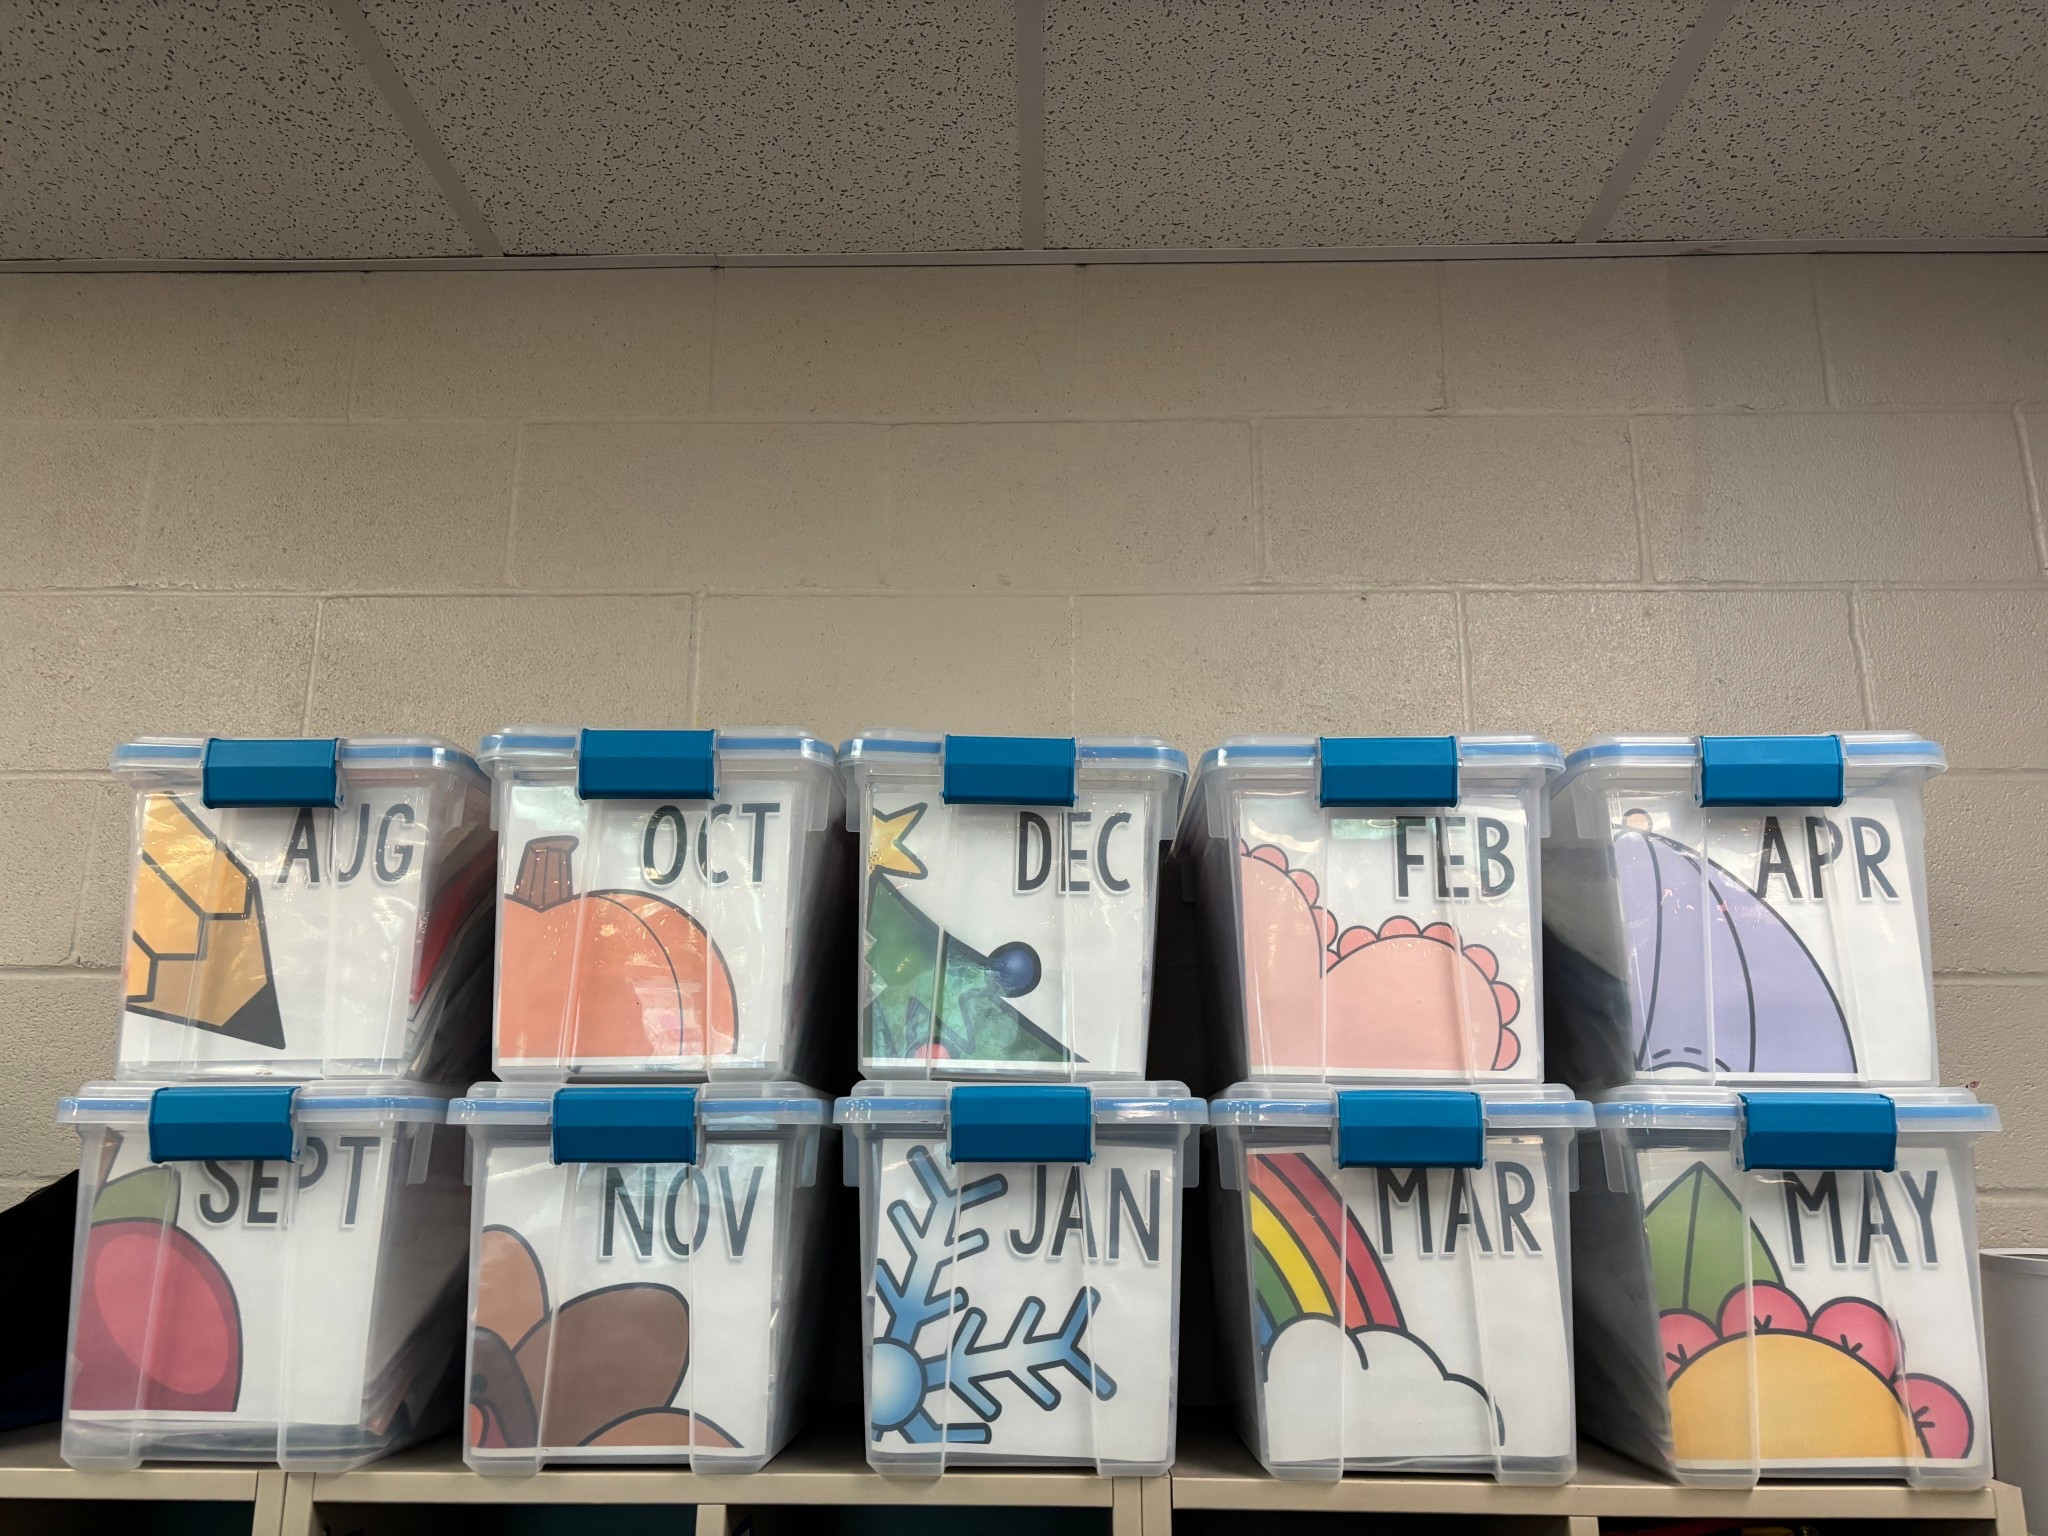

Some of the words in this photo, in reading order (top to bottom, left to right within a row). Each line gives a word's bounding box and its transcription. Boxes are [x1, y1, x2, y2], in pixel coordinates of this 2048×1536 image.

[278, 803, 415, 884] AUG
[644, 803, 780, 886] OCT
[1018, 808, 1130, 892] DEC
[1397, 817, 1515, 898] FEB
[1760, 816, 1898, 899] APR
[602, 1166, 763, 1258] NOV
[1011, 1164, 1161, 1262] JAN
[1381, 1161, 1542, 1254] MAR
[1784, 1171, 1939, 1264] MAY
